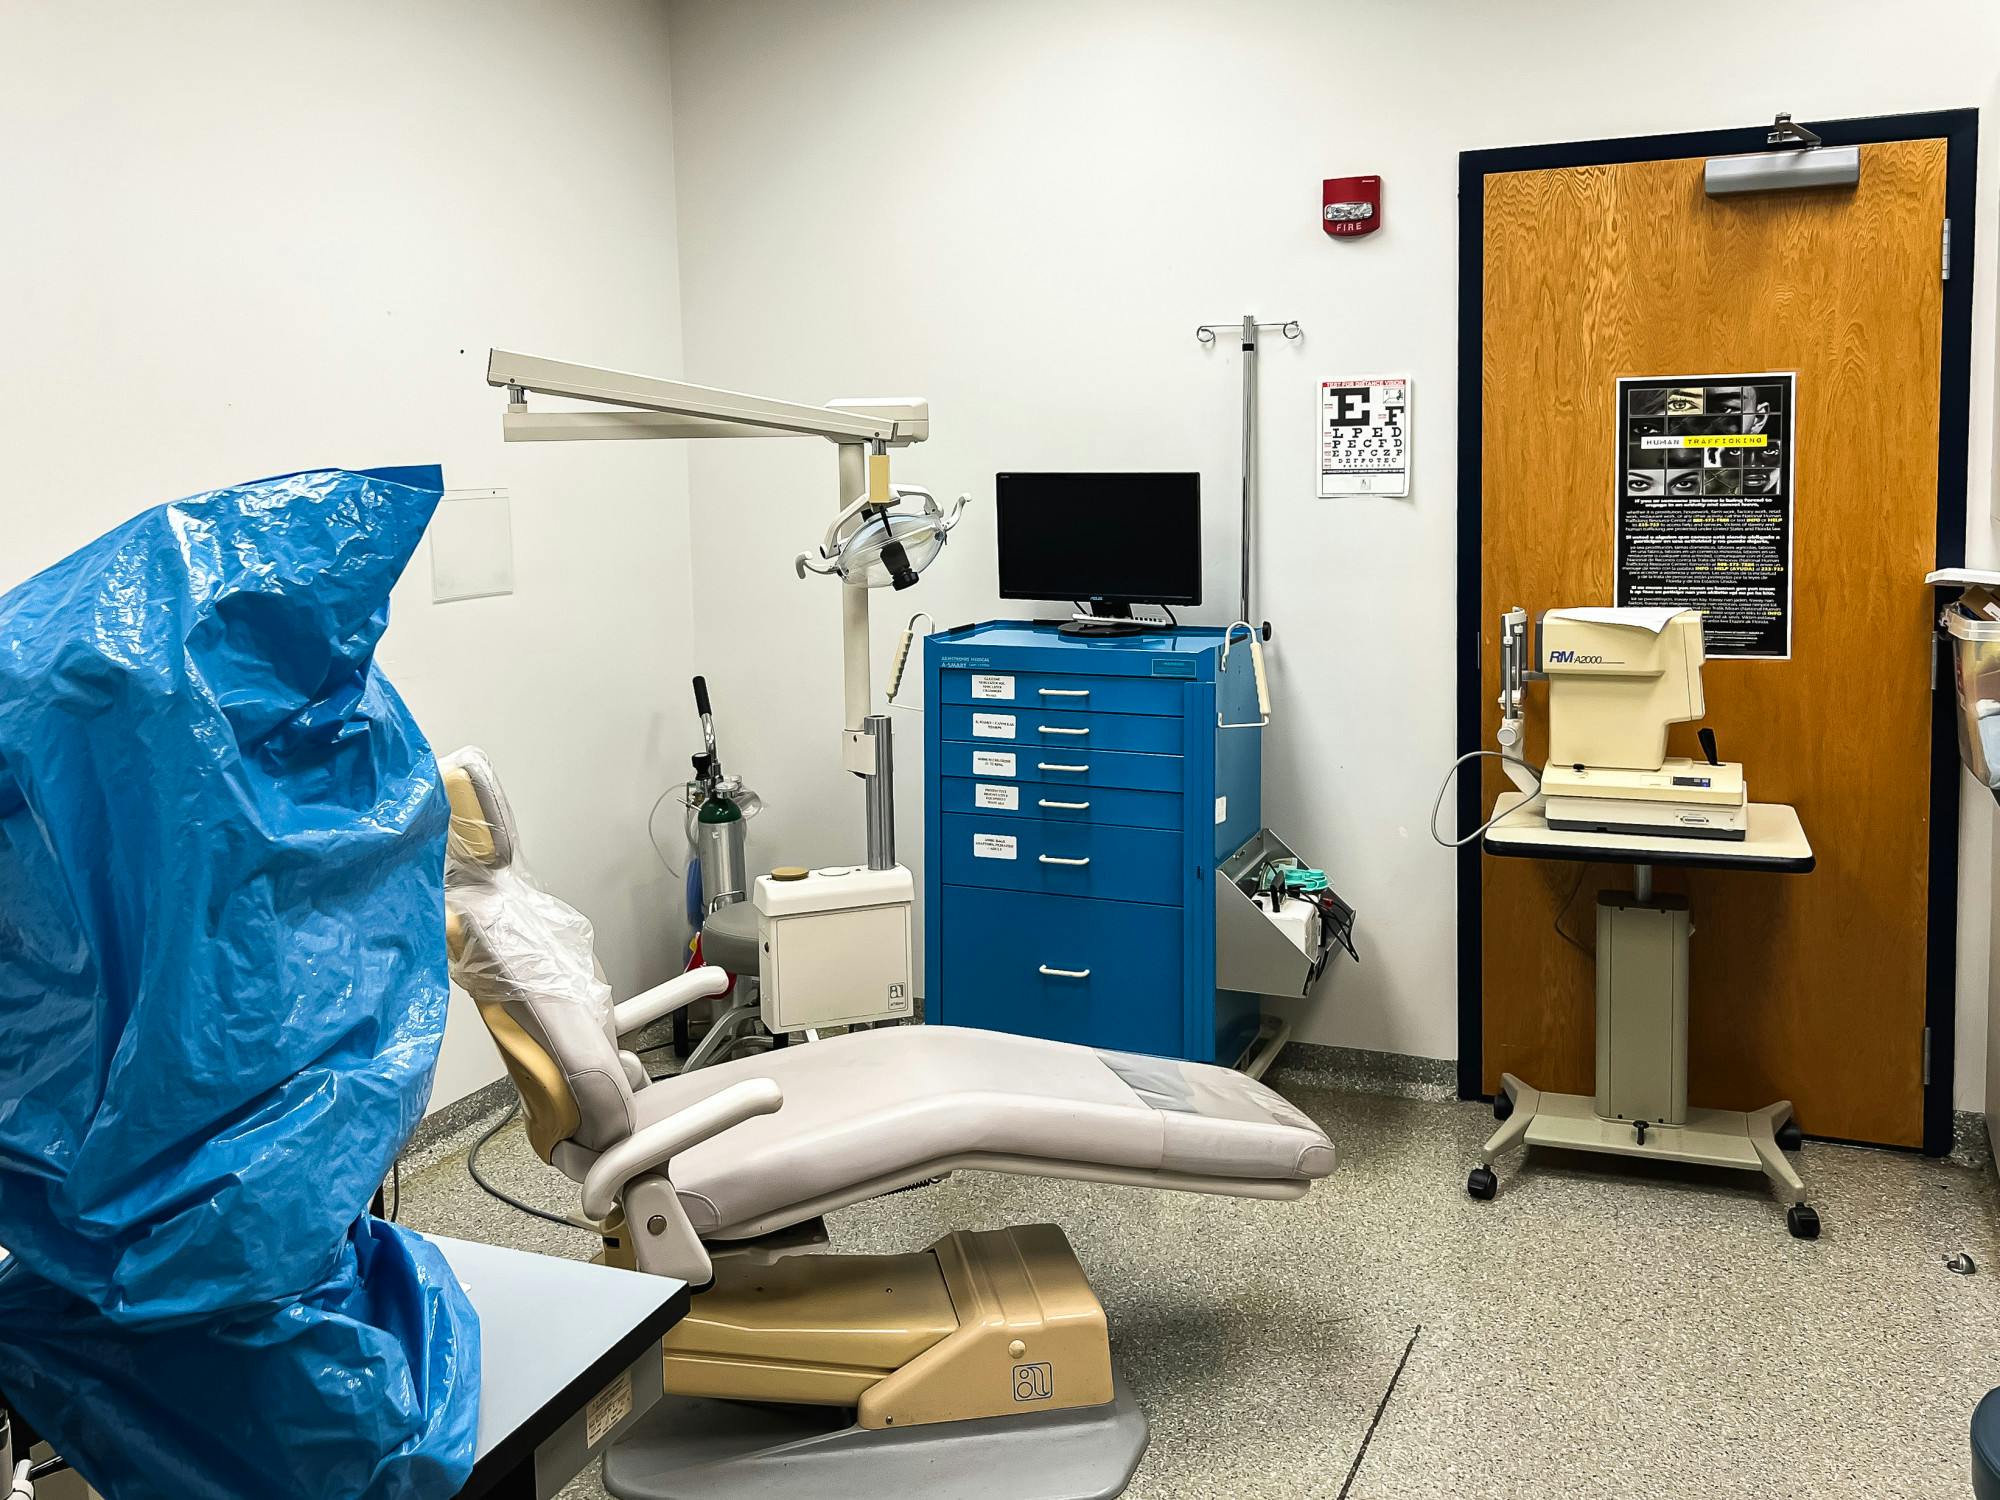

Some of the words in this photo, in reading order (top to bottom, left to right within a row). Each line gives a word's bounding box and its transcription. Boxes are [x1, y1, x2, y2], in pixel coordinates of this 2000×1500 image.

[1336, 222, 1361, 232] FIRE
[1330, 387, 1370, 426] E
[1385, 406, 1404, 426] F
[1549, 651, 1574, 663] RM
[1574, 656, 1602, 664] A2000
